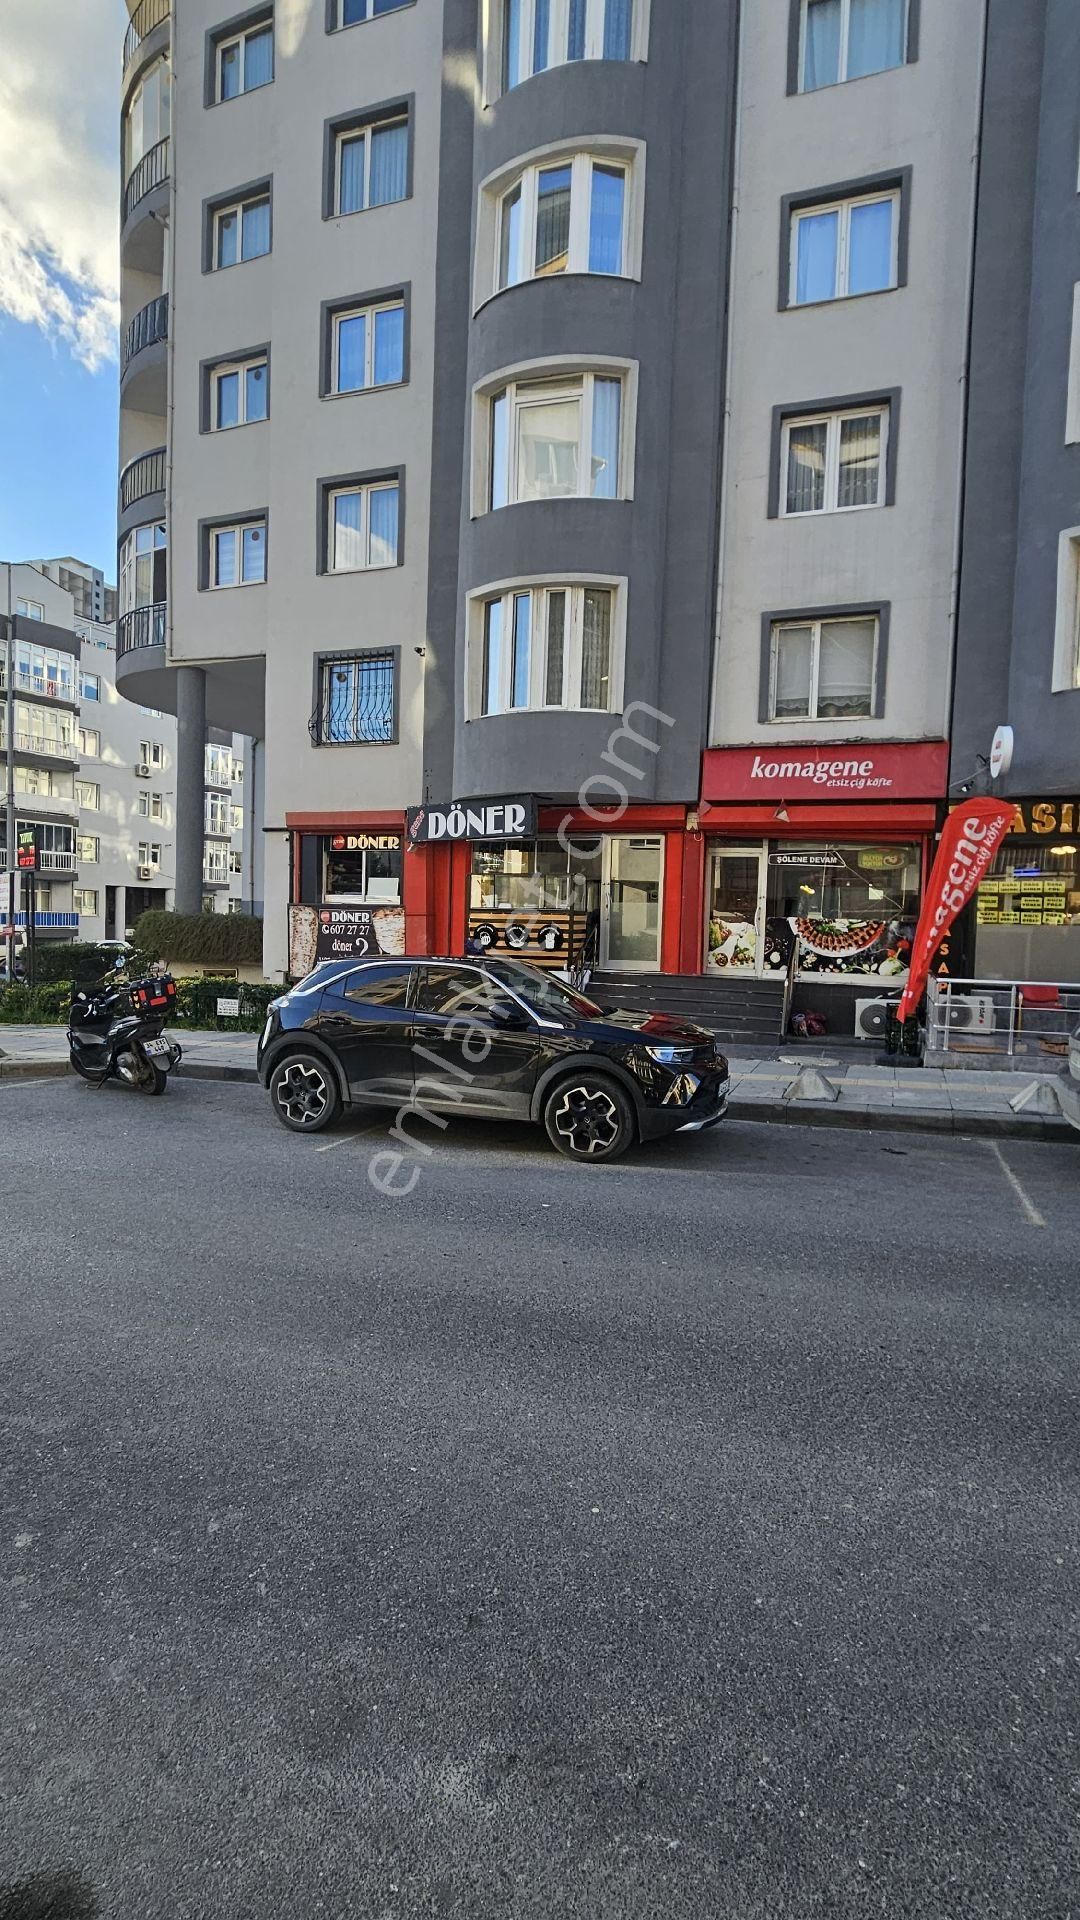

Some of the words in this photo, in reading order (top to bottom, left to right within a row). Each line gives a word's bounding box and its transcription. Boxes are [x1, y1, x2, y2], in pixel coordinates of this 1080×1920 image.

[751, 756, 873, 784] komagene
[827, 778, 849, 787] etsiz
[866, 777, 892, 788] köfte
[428, 803, 526, 839] DÖNER
[347, 834, 400, 850] DÖNER
[809, 856, 838, 864] DEVAM
[331, 910, 370, 923] DÖNER
[330, 924, 345, 935] 607
[346, 925, 357, 935] 27
[359, 925, 370, 936] 27
[331, 938, 352, 952] döner
